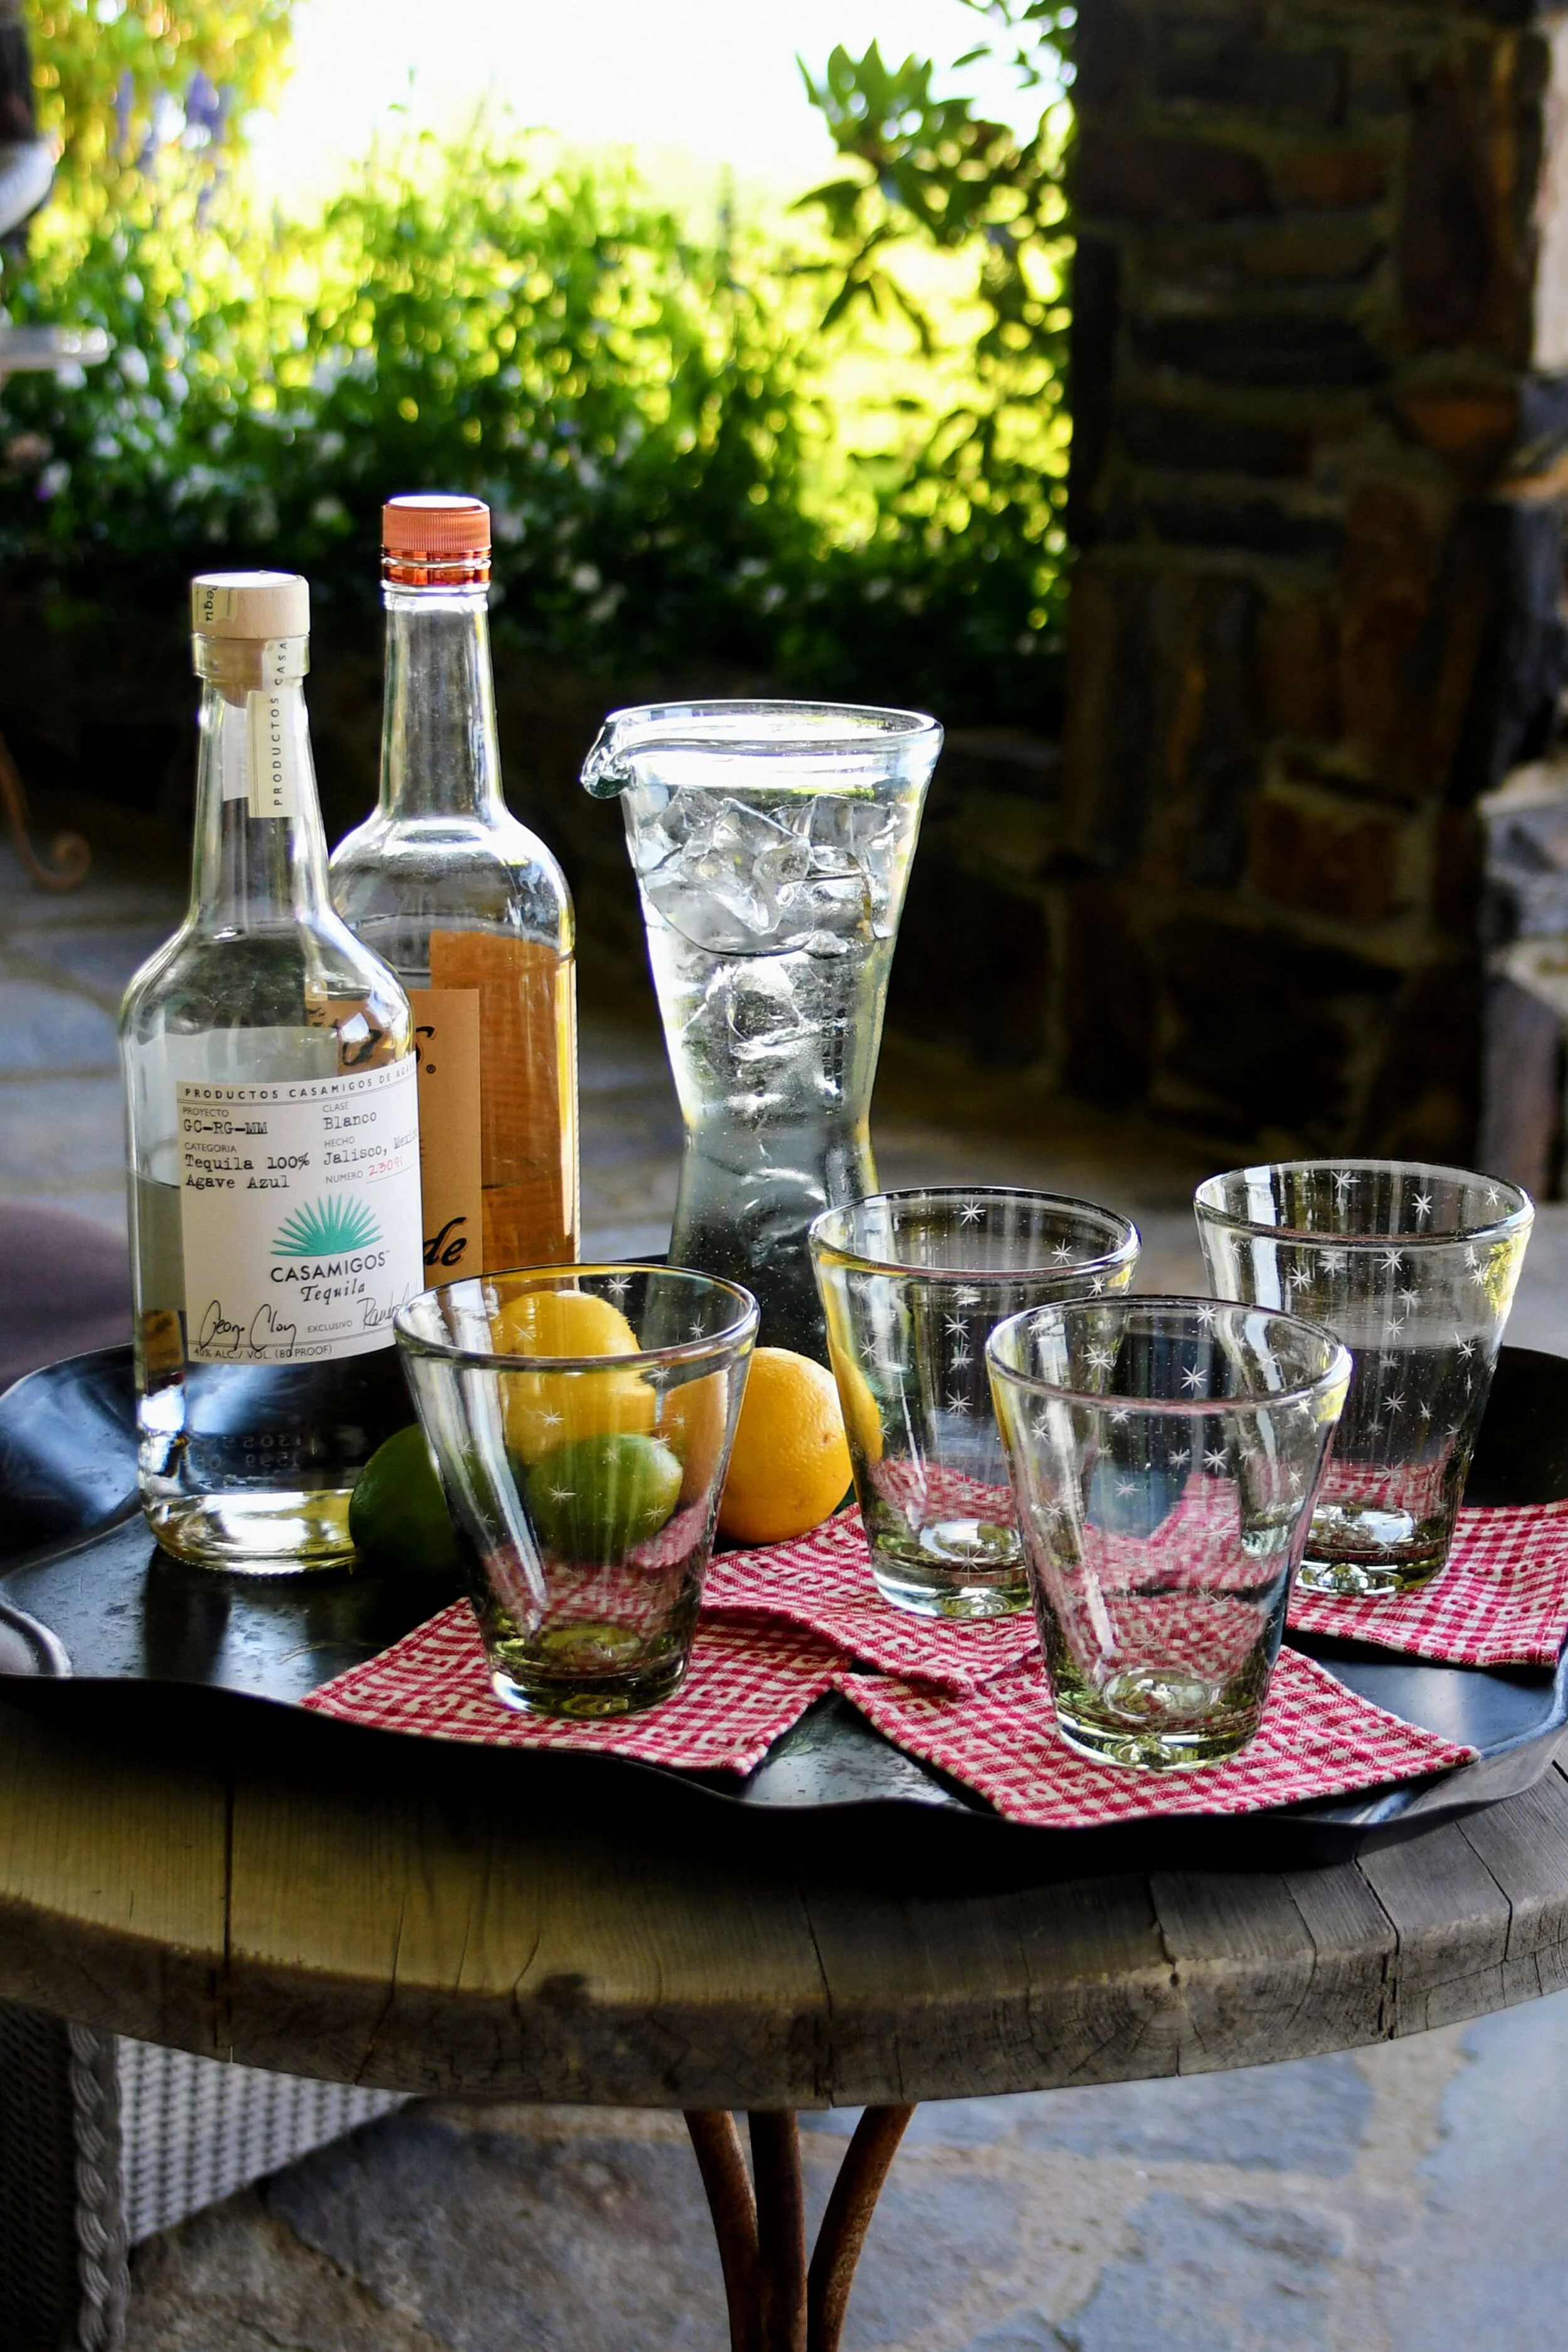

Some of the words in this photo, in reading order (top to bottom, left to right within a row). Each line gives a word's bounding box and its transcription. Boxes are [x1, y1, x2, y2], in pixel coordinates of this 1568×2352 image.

[275, 642, 287, 686] CASA
[270, 697, 283, 807] PRODUCTOS
[185, 1087, 278, 1099] PRODUCTOS
[289, 1078, 373, 1098] CASAMIGOS
[379, 1073, 391, 1084] DE
[183, 1106, 230, 1118] PROYECTO
[322, 1101, 349, 1113] CLASE
[323, 1111, 377, 1130] Blanco
[184, 1141, 237, 1152] CATEGORIA
[324, 1136, 356, 1148] HECHO
[184, 1153, 255, 1172] Tequila
[267, 1152, 310, 1170] 100%
[323, 1145, 388, 1165] Jalisco,
[186, 1173, 236, 1190] Agave
[246, 1175, 290, 1189] Azul
[325, 1170, 364, 1184] NUMERO
[270, 1251, 386, 1283] CASAMIGOS
[300, 1278, 366, 1306] Tequila
[307, 1320, 352, 1333] EXCLUSIVO
[295, 1344, 333, 1358] PROOF)
